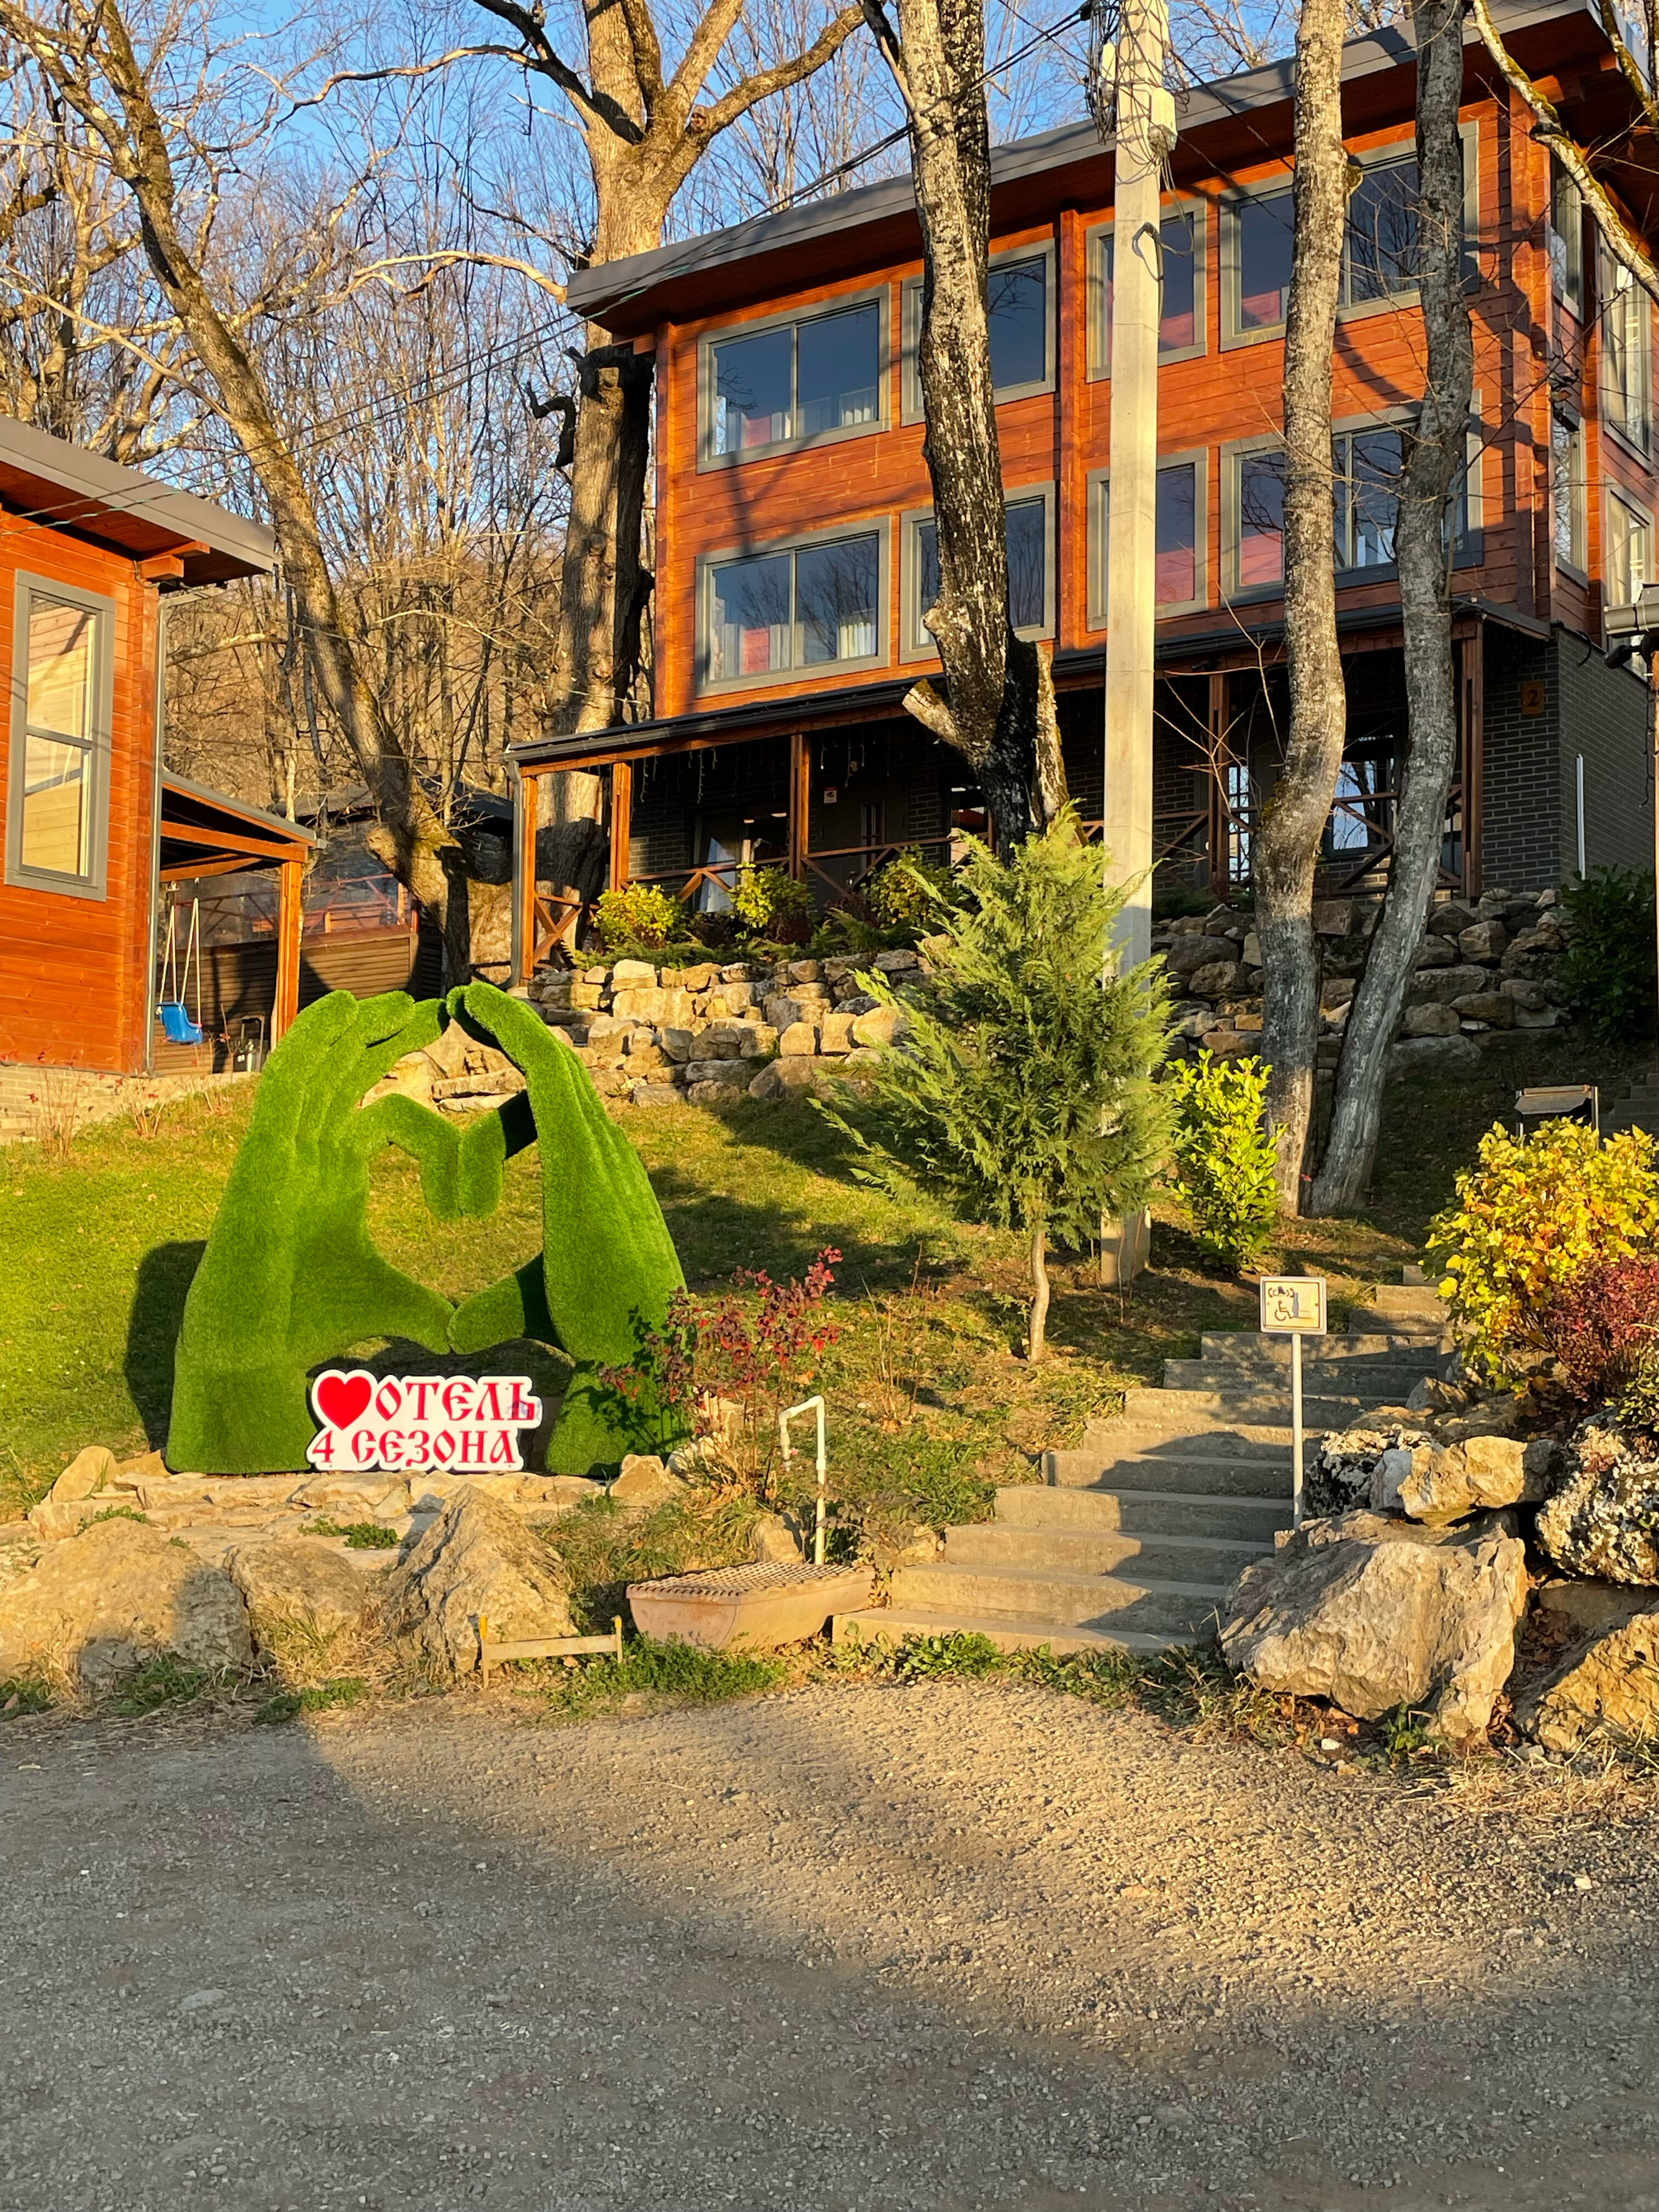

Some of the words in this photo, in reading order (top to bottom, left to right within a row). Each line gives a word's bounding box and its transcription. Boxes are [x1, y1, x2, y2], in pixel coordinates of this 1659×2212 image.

[1527, 689, 1538, 707] 2
[375, 1381, 535, 1421] ОТЕЛЬ
[312, 1430, 335, 1463] 4
[351, 1430, 516, 1466] СЕЗОНА
